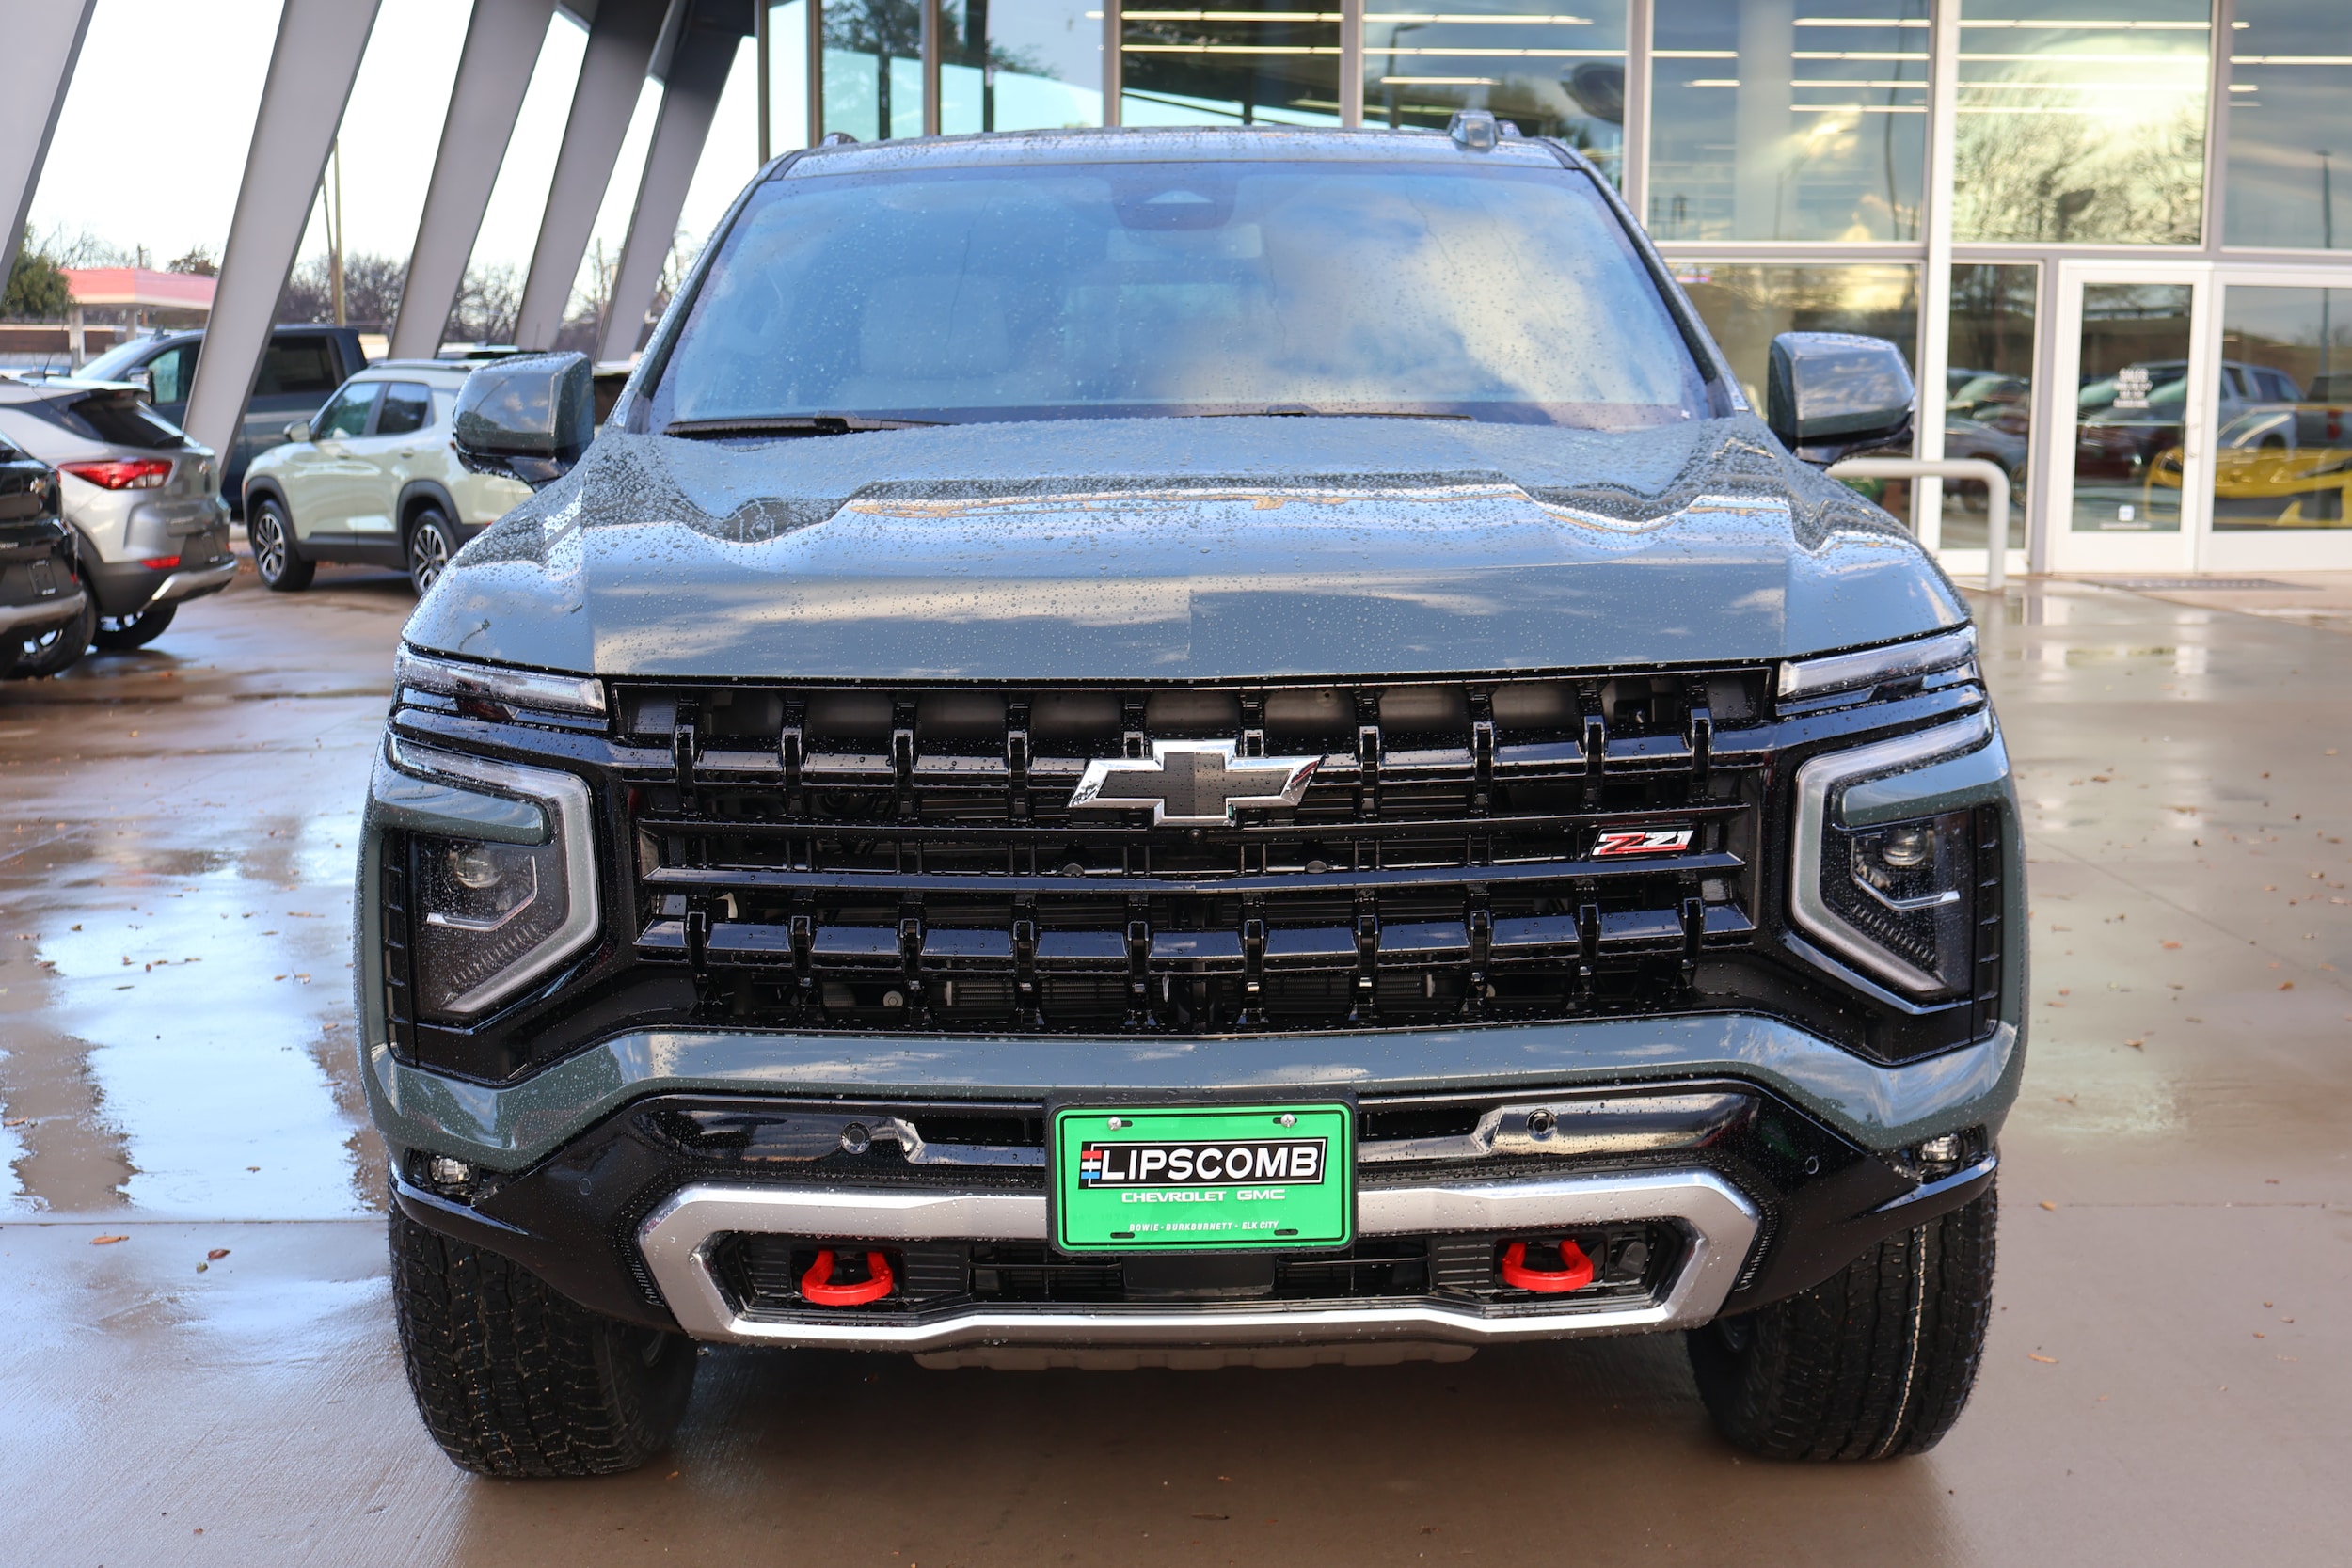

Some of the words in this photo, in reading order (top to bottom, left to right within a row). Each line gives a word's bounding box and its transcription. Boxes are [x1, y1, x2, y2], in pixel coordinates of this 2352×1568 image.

[1101, 1146, 1319, 1180] LIPSCOMB
[1121, 1191, 1227, 1203] CHEVROLET
[1236, 1189, 1286, 1201] GMC
[1129, 1223, 1159, 1232] BOWIE
[1166, 1222, 1233, 1232] BURKBURNETT
[1241, 1221, 1258, 1230] ELK
[1260, 1220, 1279, 1229] CITY
